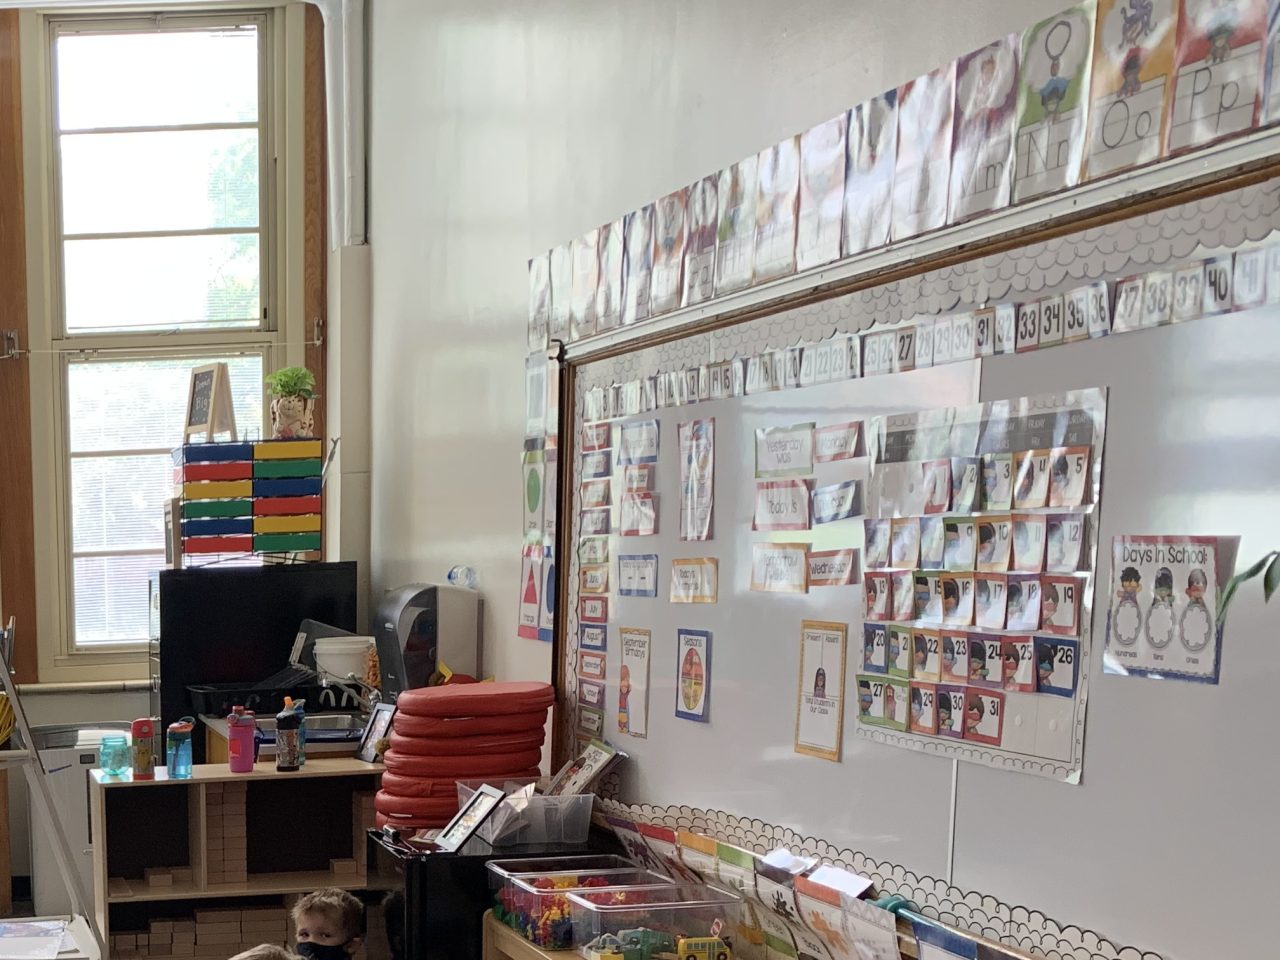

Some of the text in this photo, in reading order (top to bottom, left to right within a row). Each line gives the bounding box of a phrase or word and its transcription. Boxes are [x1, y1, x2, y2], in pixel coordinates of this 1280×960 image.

[898, 334, 913, 361] 27
[953, 324, 970, 352] 30
[977, 317, 990, 347] 31
[1019, 309, 1037, 341] 33
[1042, 302, 1061, 335] 34
[1067, 297, 1086, 331] 35
[1090, 292, 1107, 324] 36
[1146, 281, 1169, 314] 38
[1177, 273, 1200, 309] 39
[1207, 268, 1229, 302] 40
[776, 452, 792, 464] was
[969, 466, 976, 483] 2
[1003, 463, 1011, 480] 3
[1039, 458, 1047, 472] 4
[1076, 456, 1084, 474] 5
[768, 499, 789, 515] Today
[966, 525, 973, 539] 9
[998, 526, 1009, 541] 10
[1070, 524, 1079, 542] 12
[1122, 545, 1153, 566] Days
[1167, 545, 1208, 566] School:
[878, 576, 1074, 604] 13 15 16 17 18 19
[585, 630, 601, 642] August
[623, 636, 648, 650] September
[683, 636, 703, 648] Seasons
[875, 632, 1074, 666] 20 21 22 23 24 25 26
[872, 683, 884, 698] 27
[923, 691, 934, 708] 29
[952, 695, 964, 712] 30
[989, 700, 1000, 717] 31
